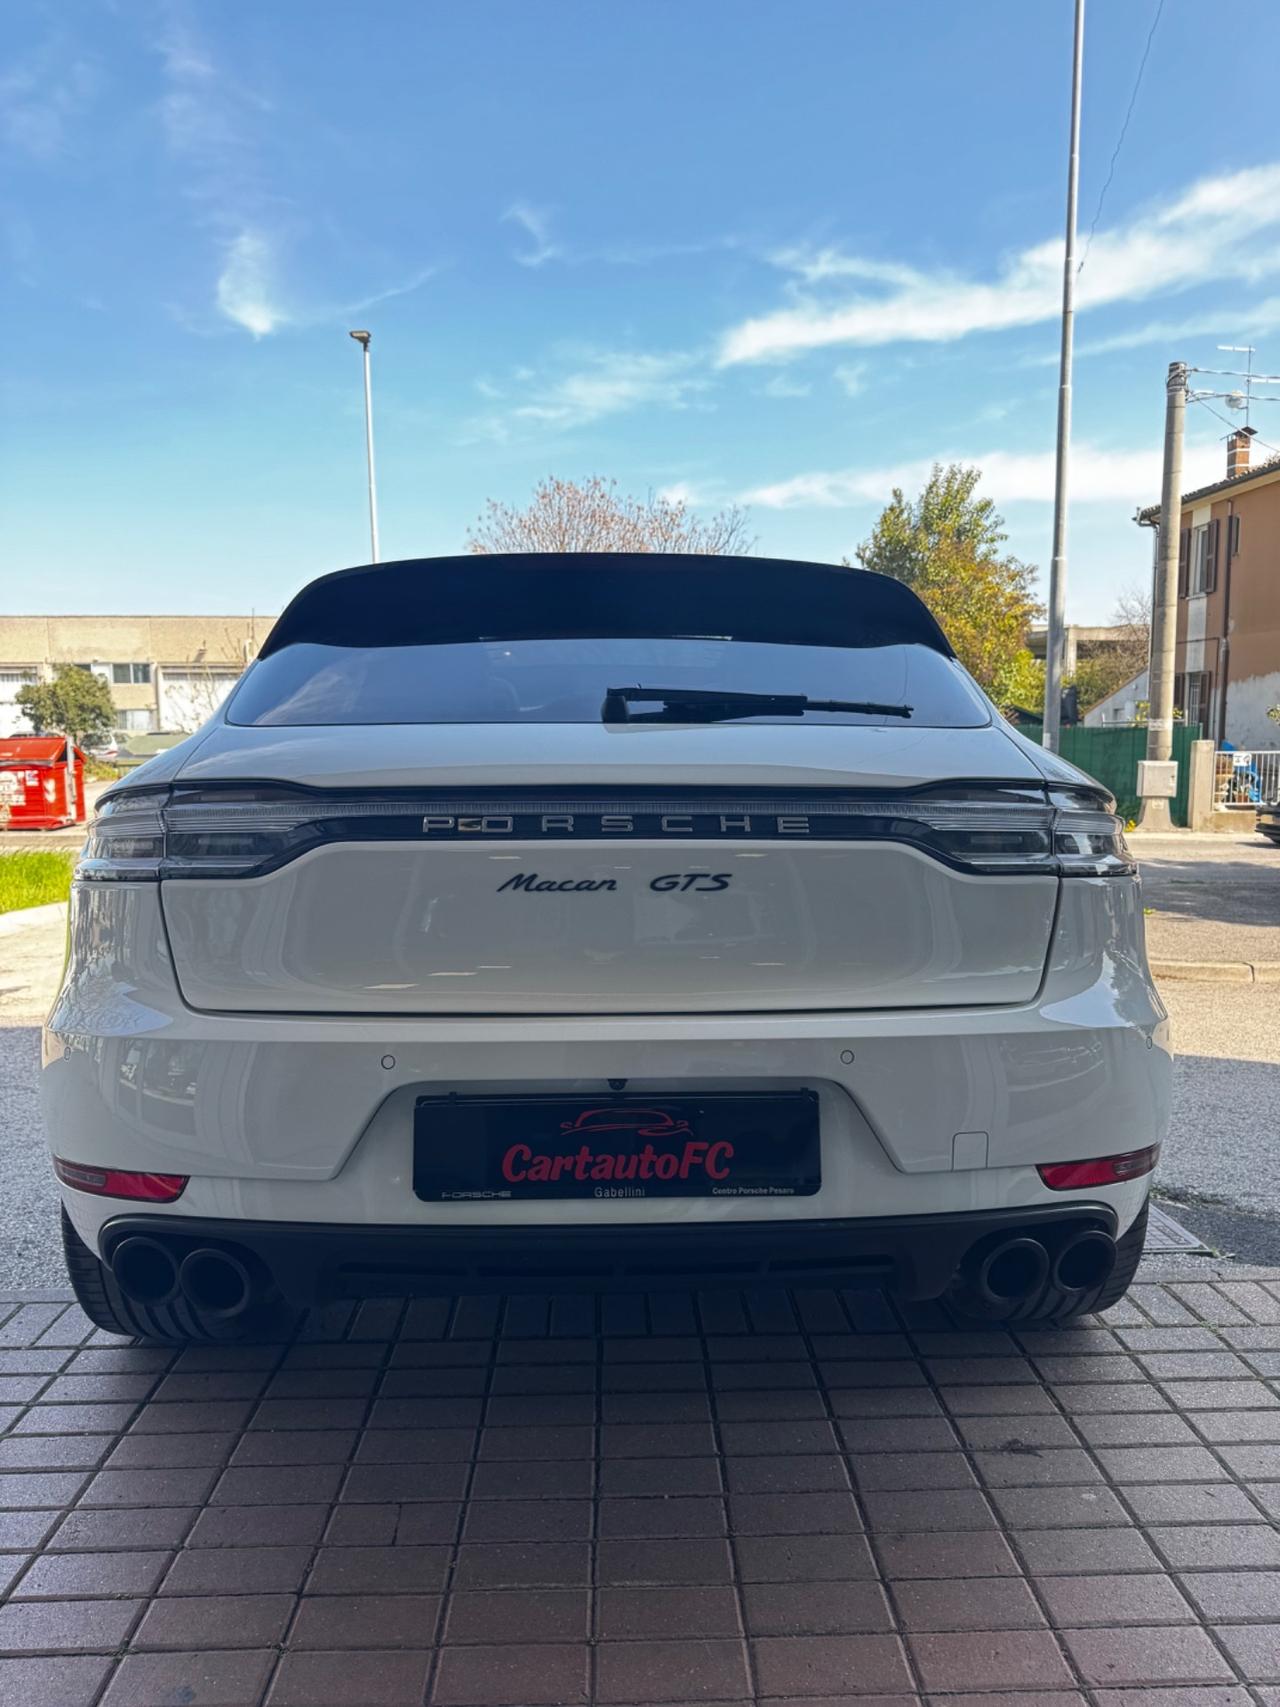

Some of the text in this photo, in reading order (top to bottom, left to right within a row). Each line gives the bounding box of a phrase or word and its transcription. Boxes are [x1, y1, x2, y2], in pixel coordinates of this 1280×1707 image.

[422, 814, 811, 834] PORSCHE
[497, 872, 734, 893] Macan GTS
[502, 1141, 735, 1183] CartautoFC
[594, 1186, 646, 1198] Gabellini
